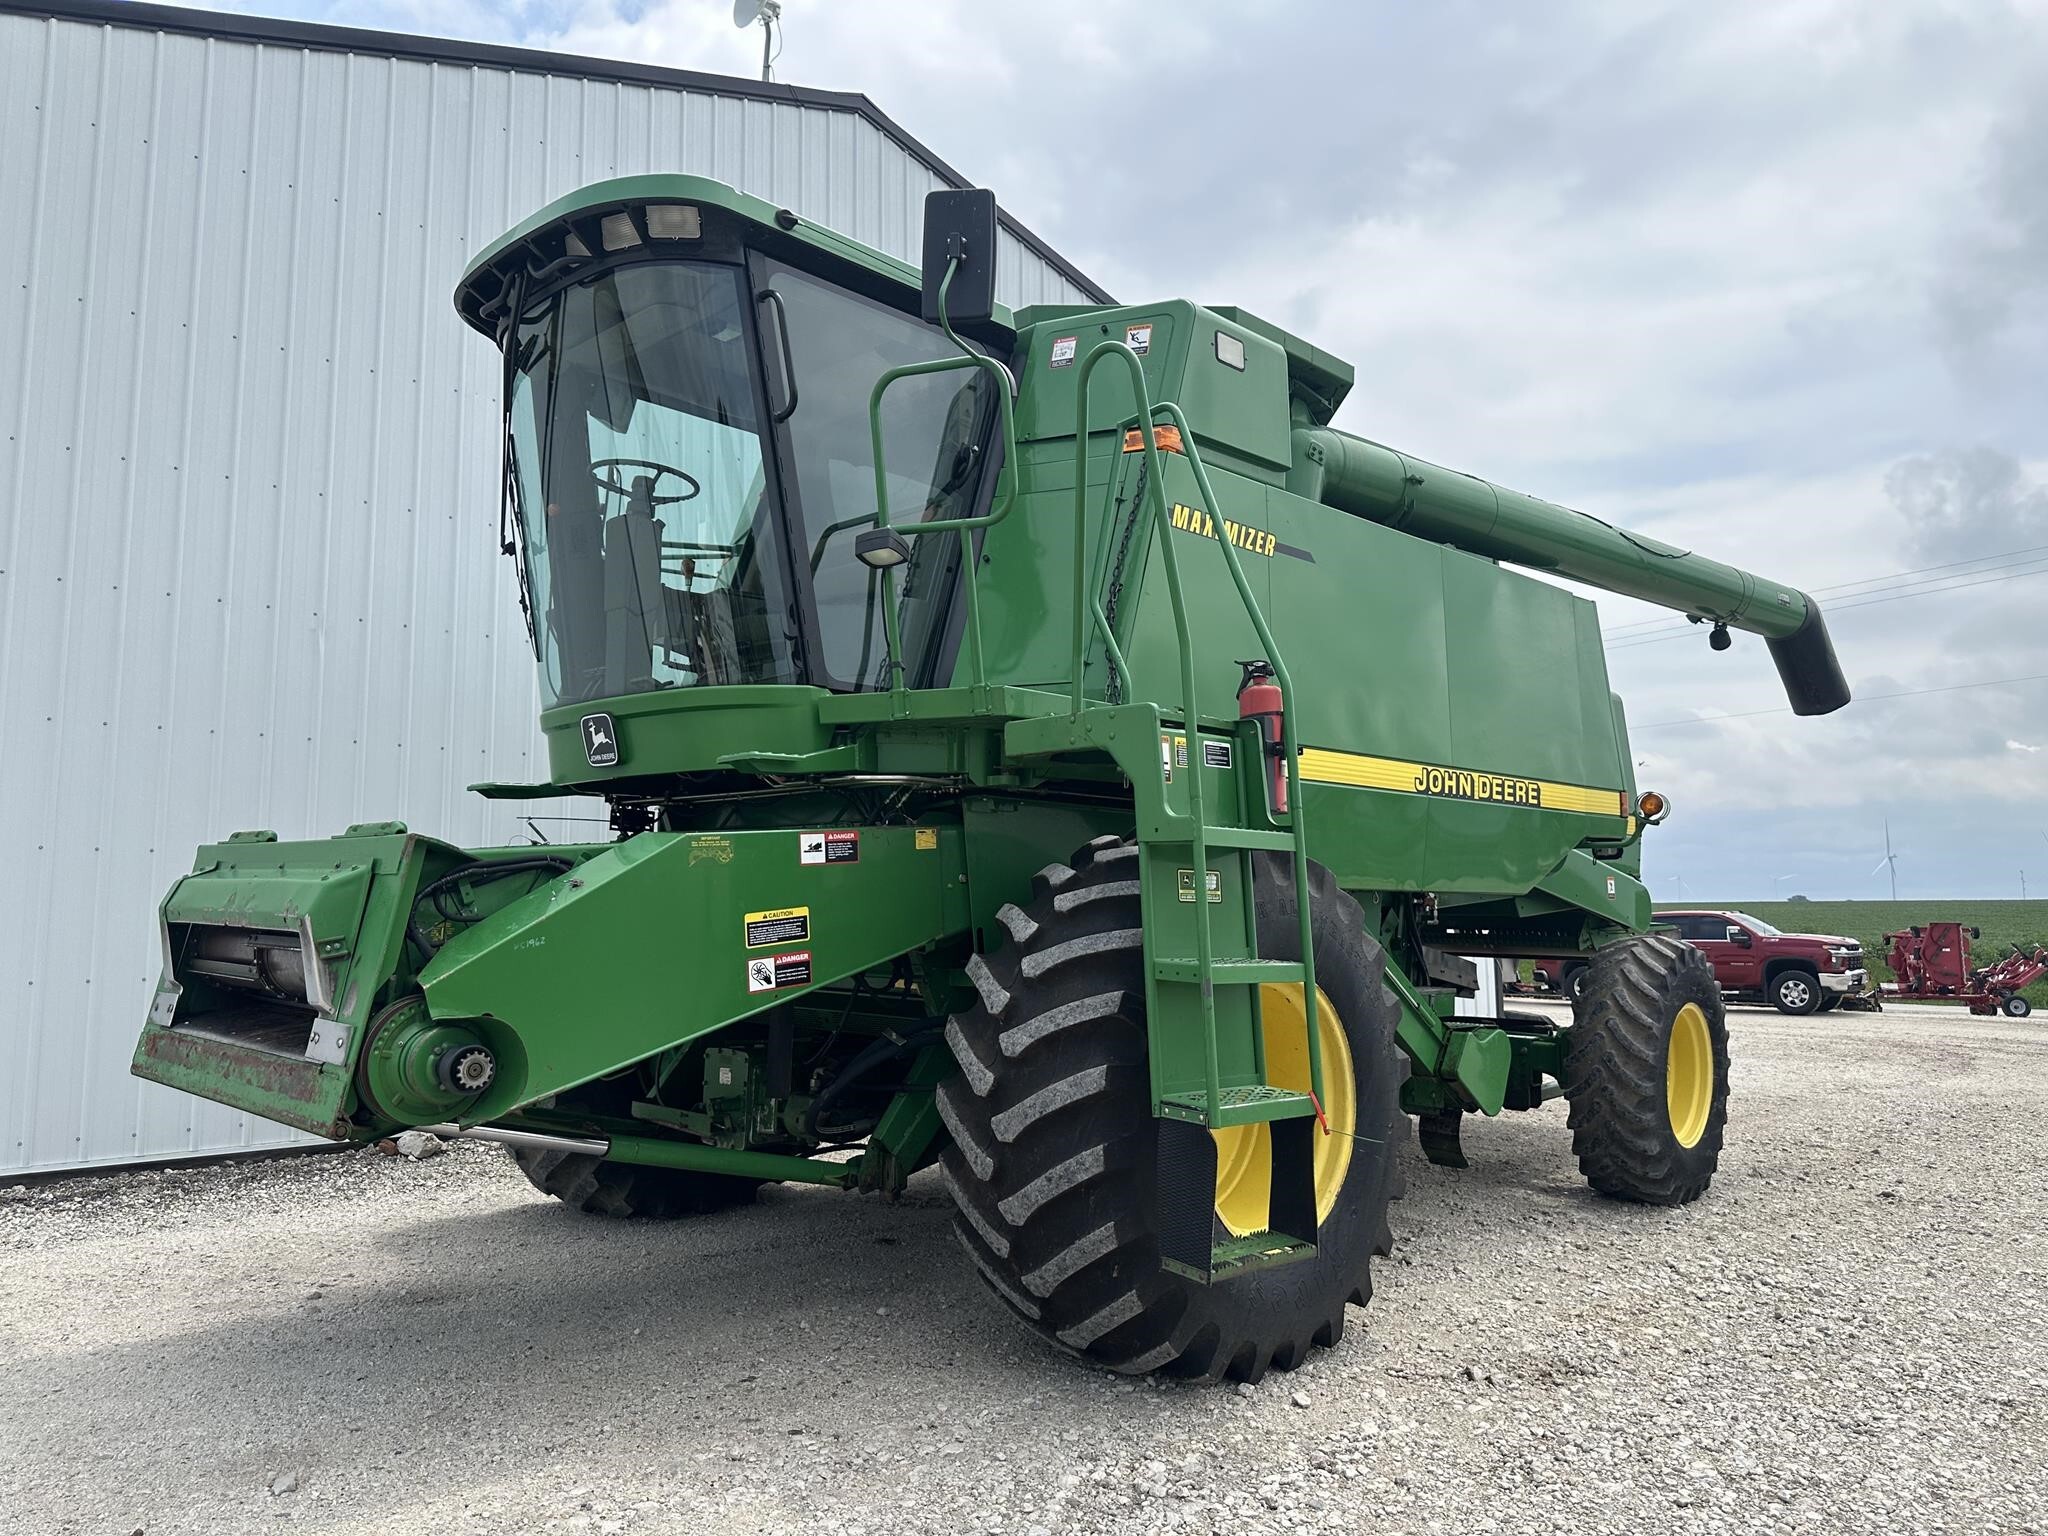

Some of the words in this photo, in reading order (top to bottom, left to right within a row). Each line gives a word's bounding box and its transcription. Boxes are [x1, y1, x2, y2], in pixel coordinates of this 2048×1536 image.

[1171, 502, 1277, 558] MAXMIZER
[590, 754, 602, 762] JOHN
[602, 752, 616, 760] DEERE
[1415, 767, 1475, 798] JOHN
[1477, 774, 1541, 806] DEERE
[833, 832, 855, 840] DANGER
[768, 910, 794, 919] CAUTION
[781, 953, 809, 963] DANGER
